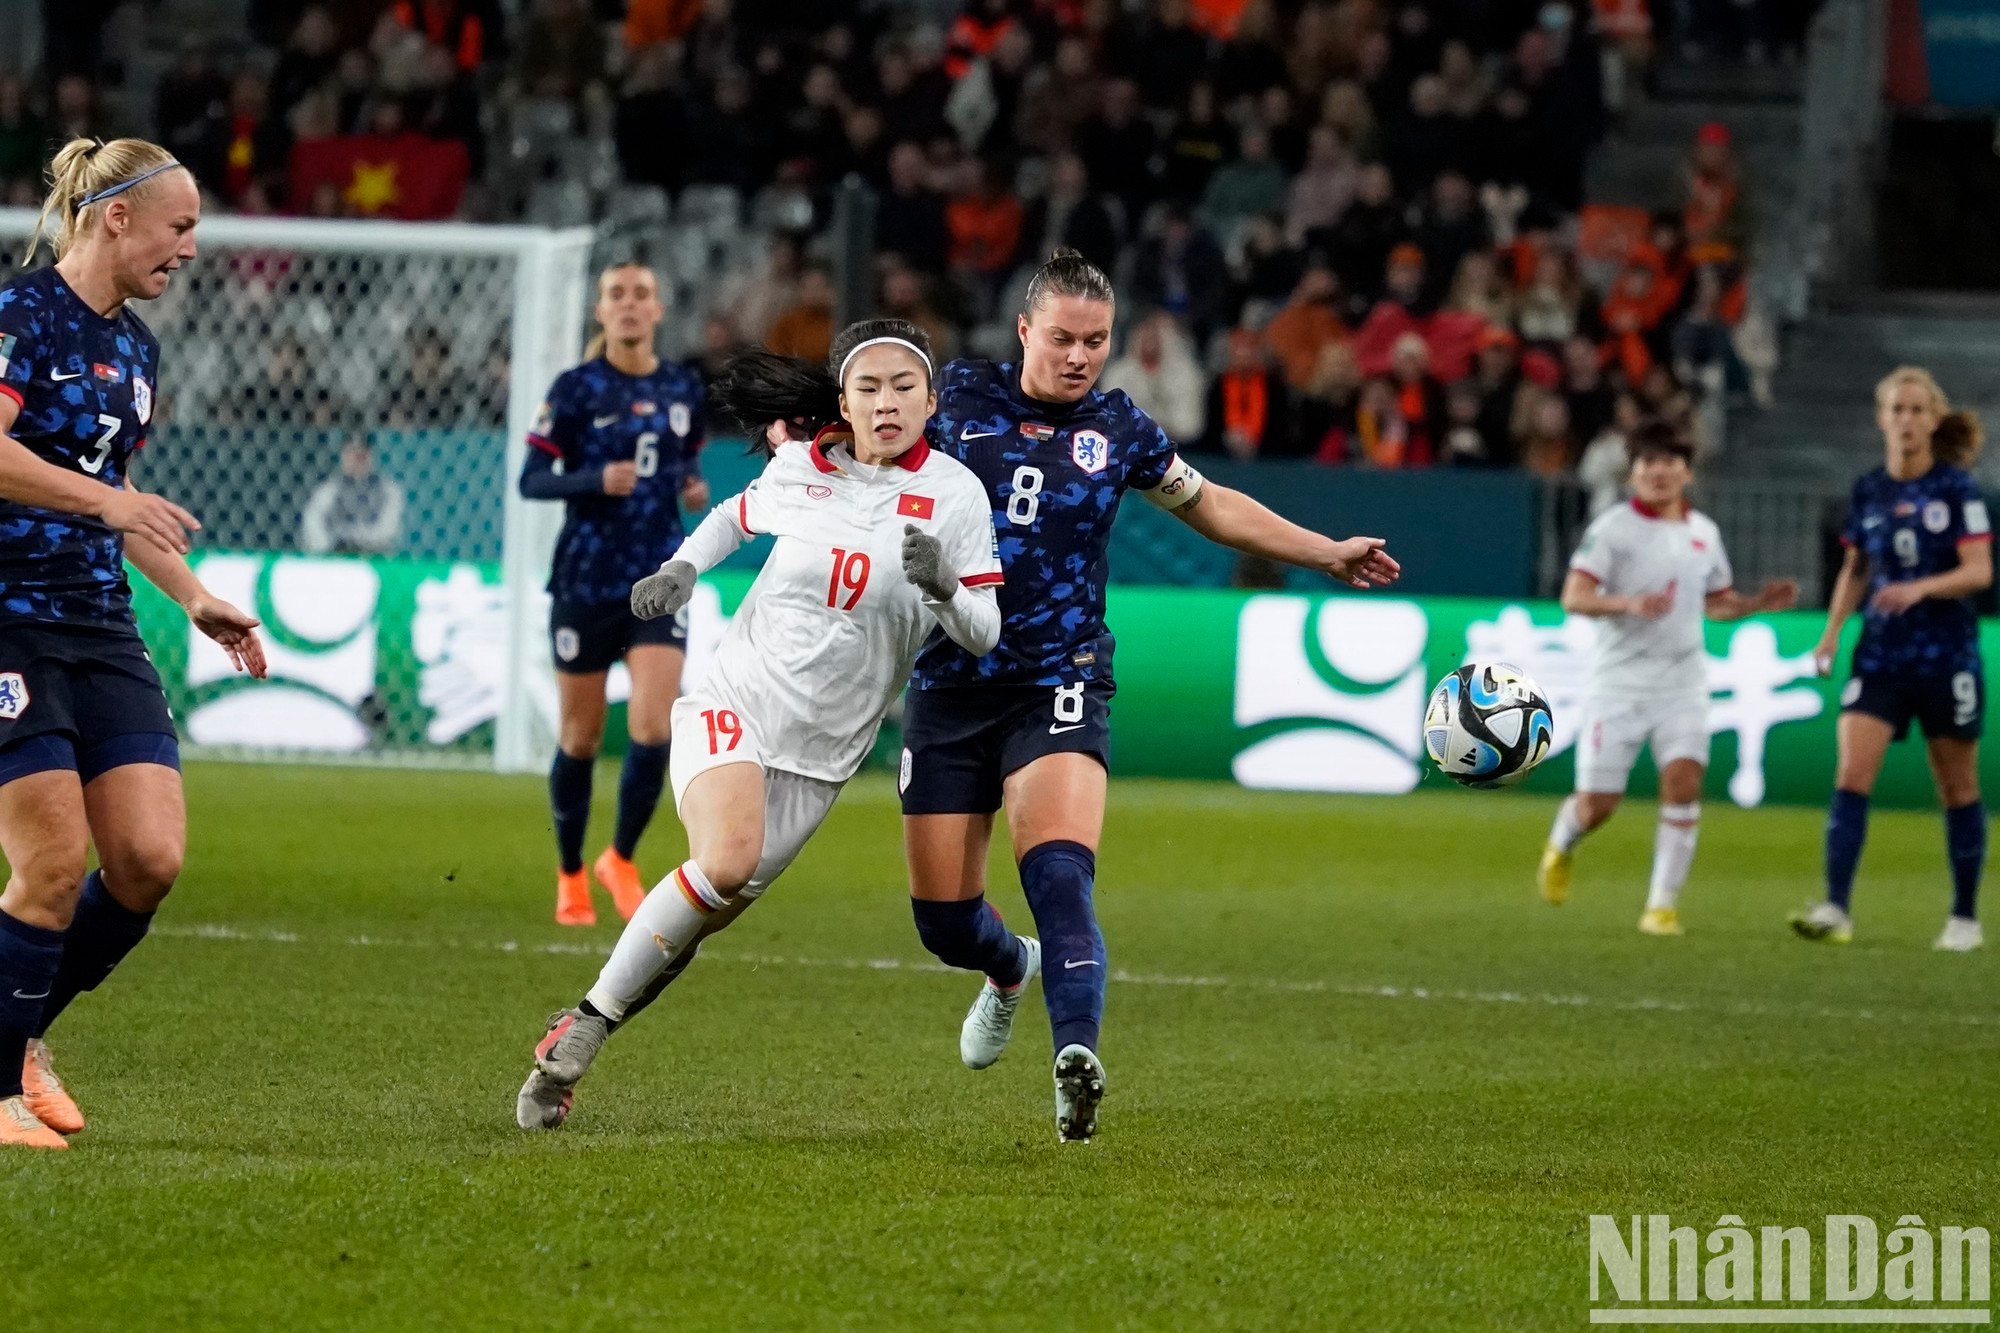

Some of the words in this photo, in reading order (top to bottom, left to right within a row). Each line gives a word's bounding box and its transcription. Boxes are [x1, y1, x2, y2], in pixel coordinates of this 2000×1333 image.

[78, 415, 122, 475] 3
[635, 432, 659, 477] 6
[1006, 466, 1045, 526] 8
[1893, 528, 1919, 568] 9
[826, 547, 871, 611] 19
[1053, 681, 1085, 723] 8
[1951, 670, 1977, 715] 9
[700, 708, 743, 755] 19
